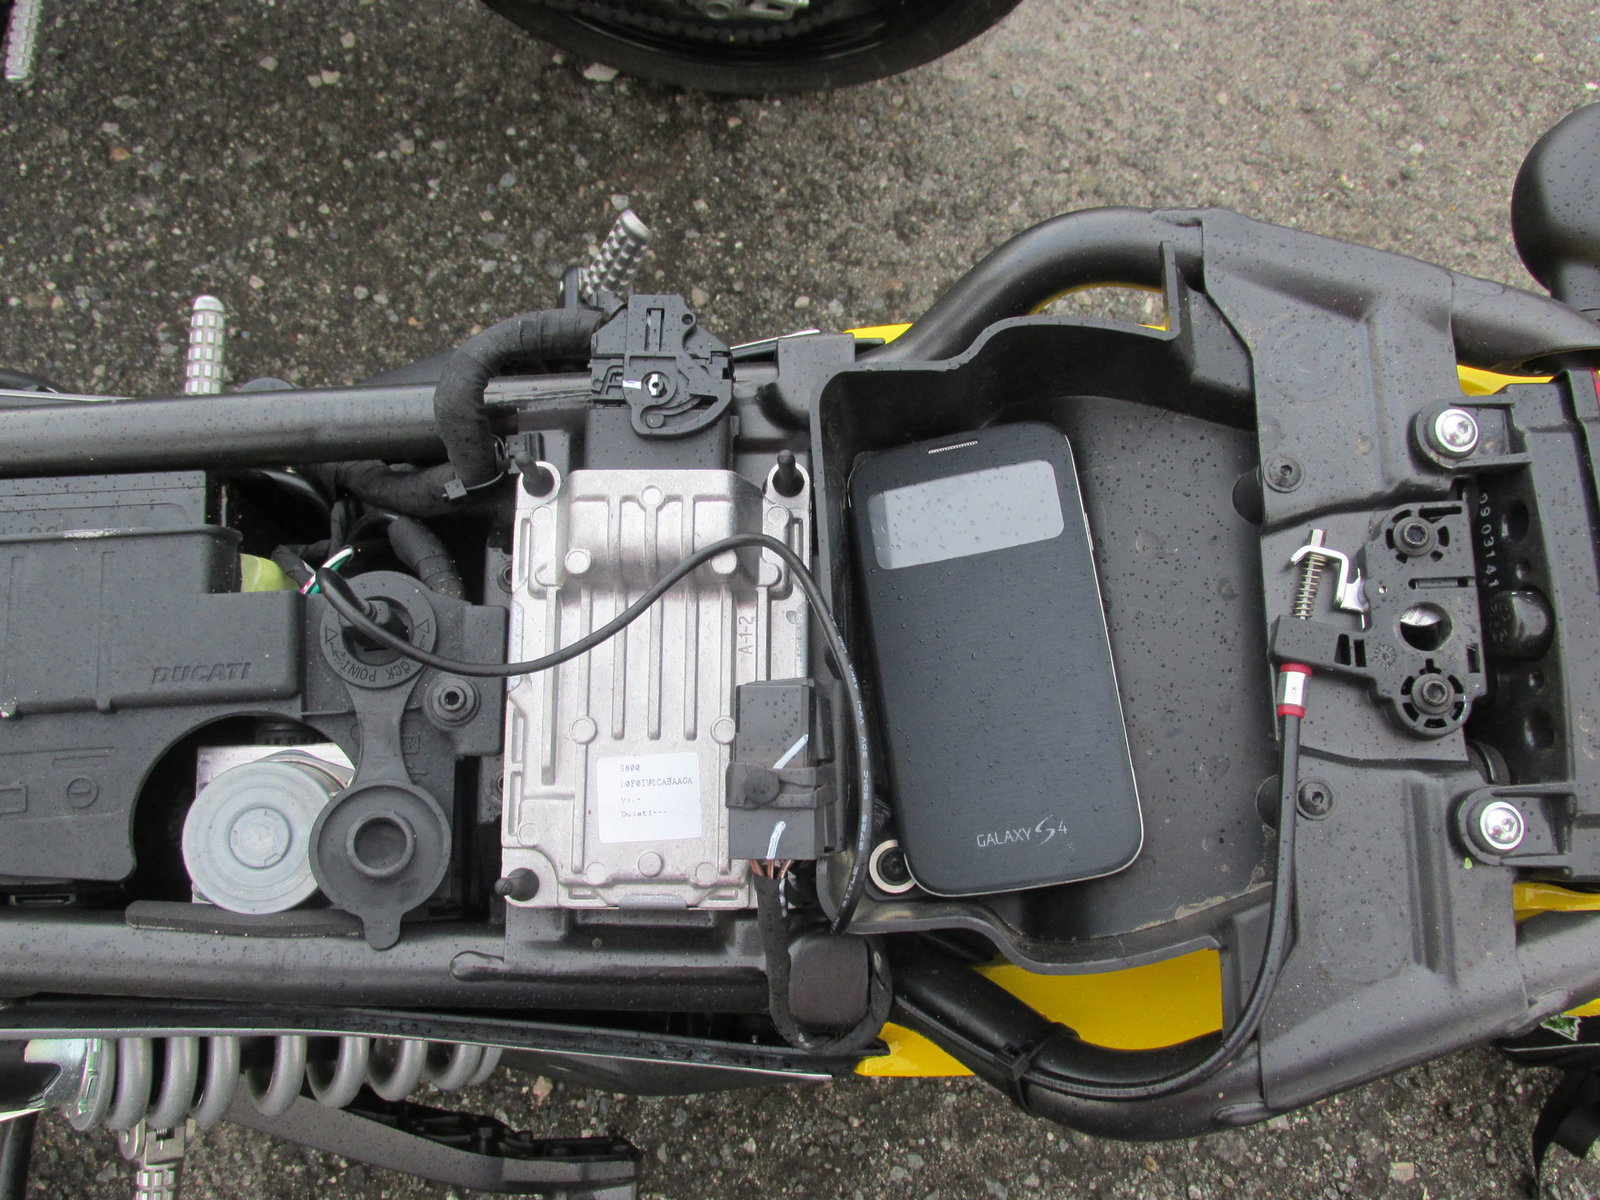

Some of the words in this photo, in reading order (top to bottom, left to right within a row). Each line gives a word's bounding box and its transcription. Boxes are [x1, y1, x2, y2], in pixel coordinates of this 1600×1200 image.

[738, 615, 755, 655] A-1-2
[151, 662, 252, 684] DUCATI
[340, 662, 377, 682] POINT
[976, 826, 1032, 848] GALAXY
[841, 864, 859, 908] STYLE
[857, 814, 867, 851] 2725
